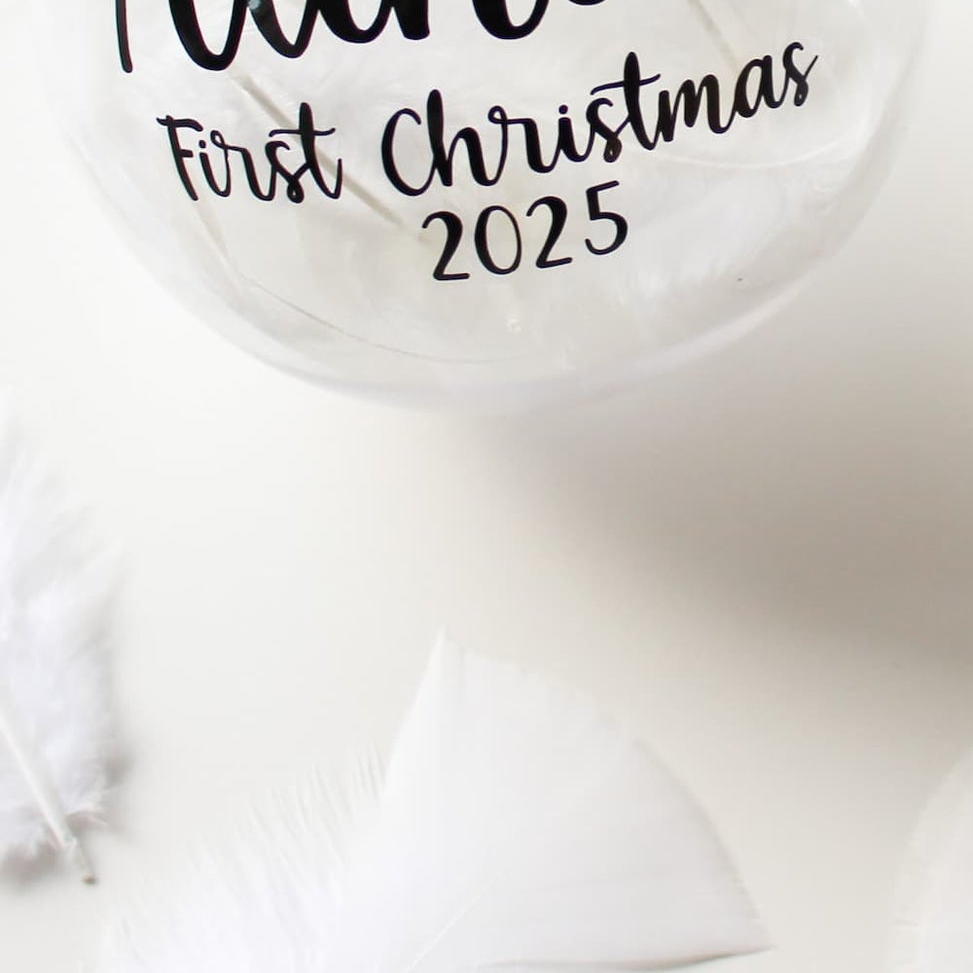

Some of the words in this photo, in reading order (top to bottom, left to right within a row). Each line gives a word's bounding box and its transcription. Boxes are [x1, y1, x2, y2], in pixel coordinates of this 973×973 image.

[156, 102, 343, 204] First
[381, 41, 820, 197] Christmas
[421, 180, 629, 282] 2025
